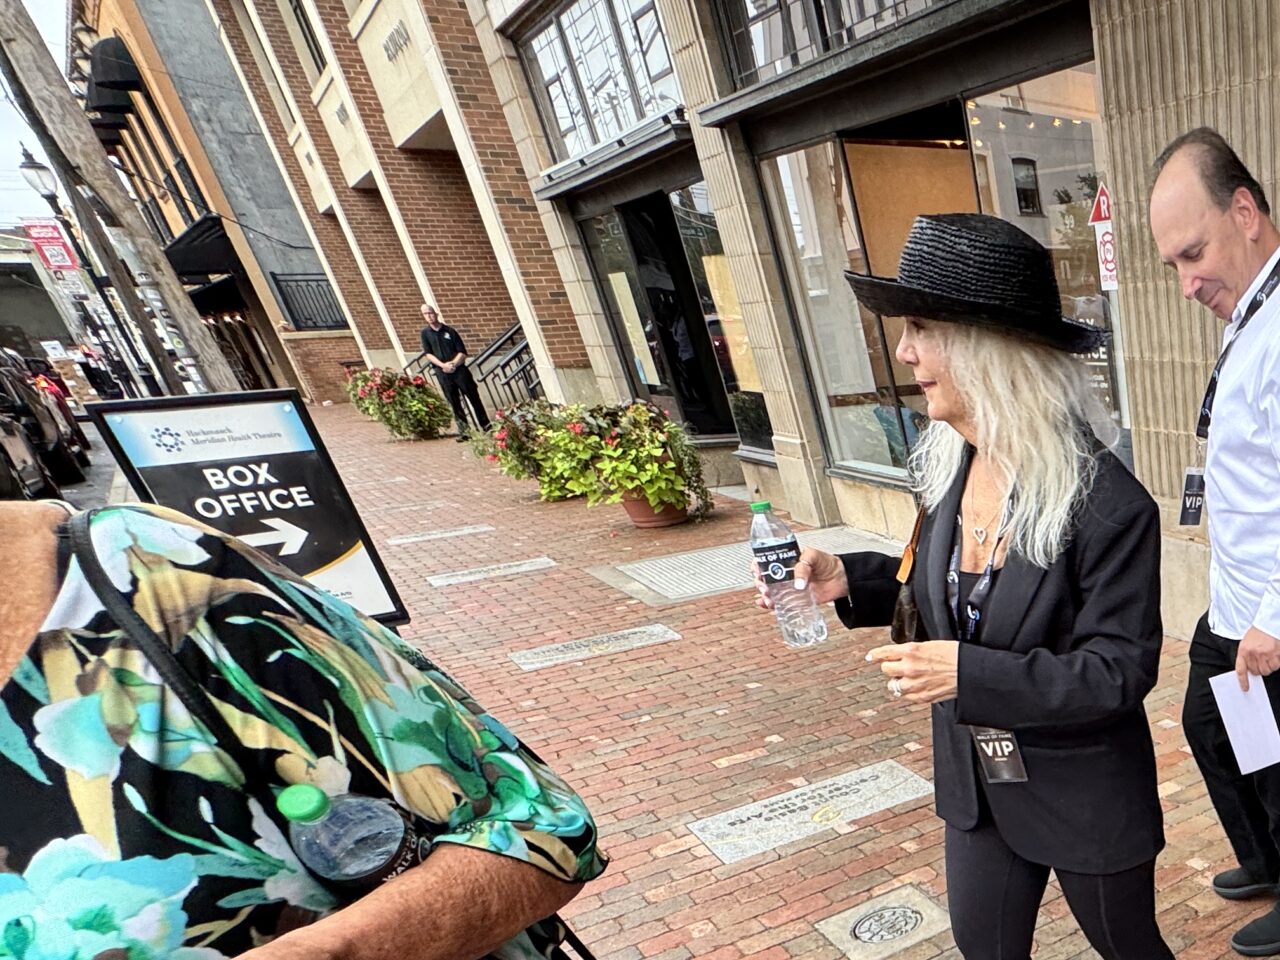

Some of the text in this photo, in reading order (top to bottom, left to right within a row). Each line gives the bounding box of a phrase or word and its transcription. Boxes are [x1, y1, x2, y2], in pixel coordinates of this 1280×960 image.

[1100, 195, 1109, 218] R
[186, 427, 233, 437] Hackensack
[191, 436, 226, 445] Meridian
[202, 462, 279, 491] BOX
[195, 485, 316, 519] OFFICE
[1185, 496, 1203, 508] VIP
[980, 741, 1014, 757] VIP
[728, 812, 763, 827] Arts
[382, 850, 414, 881] WALK
